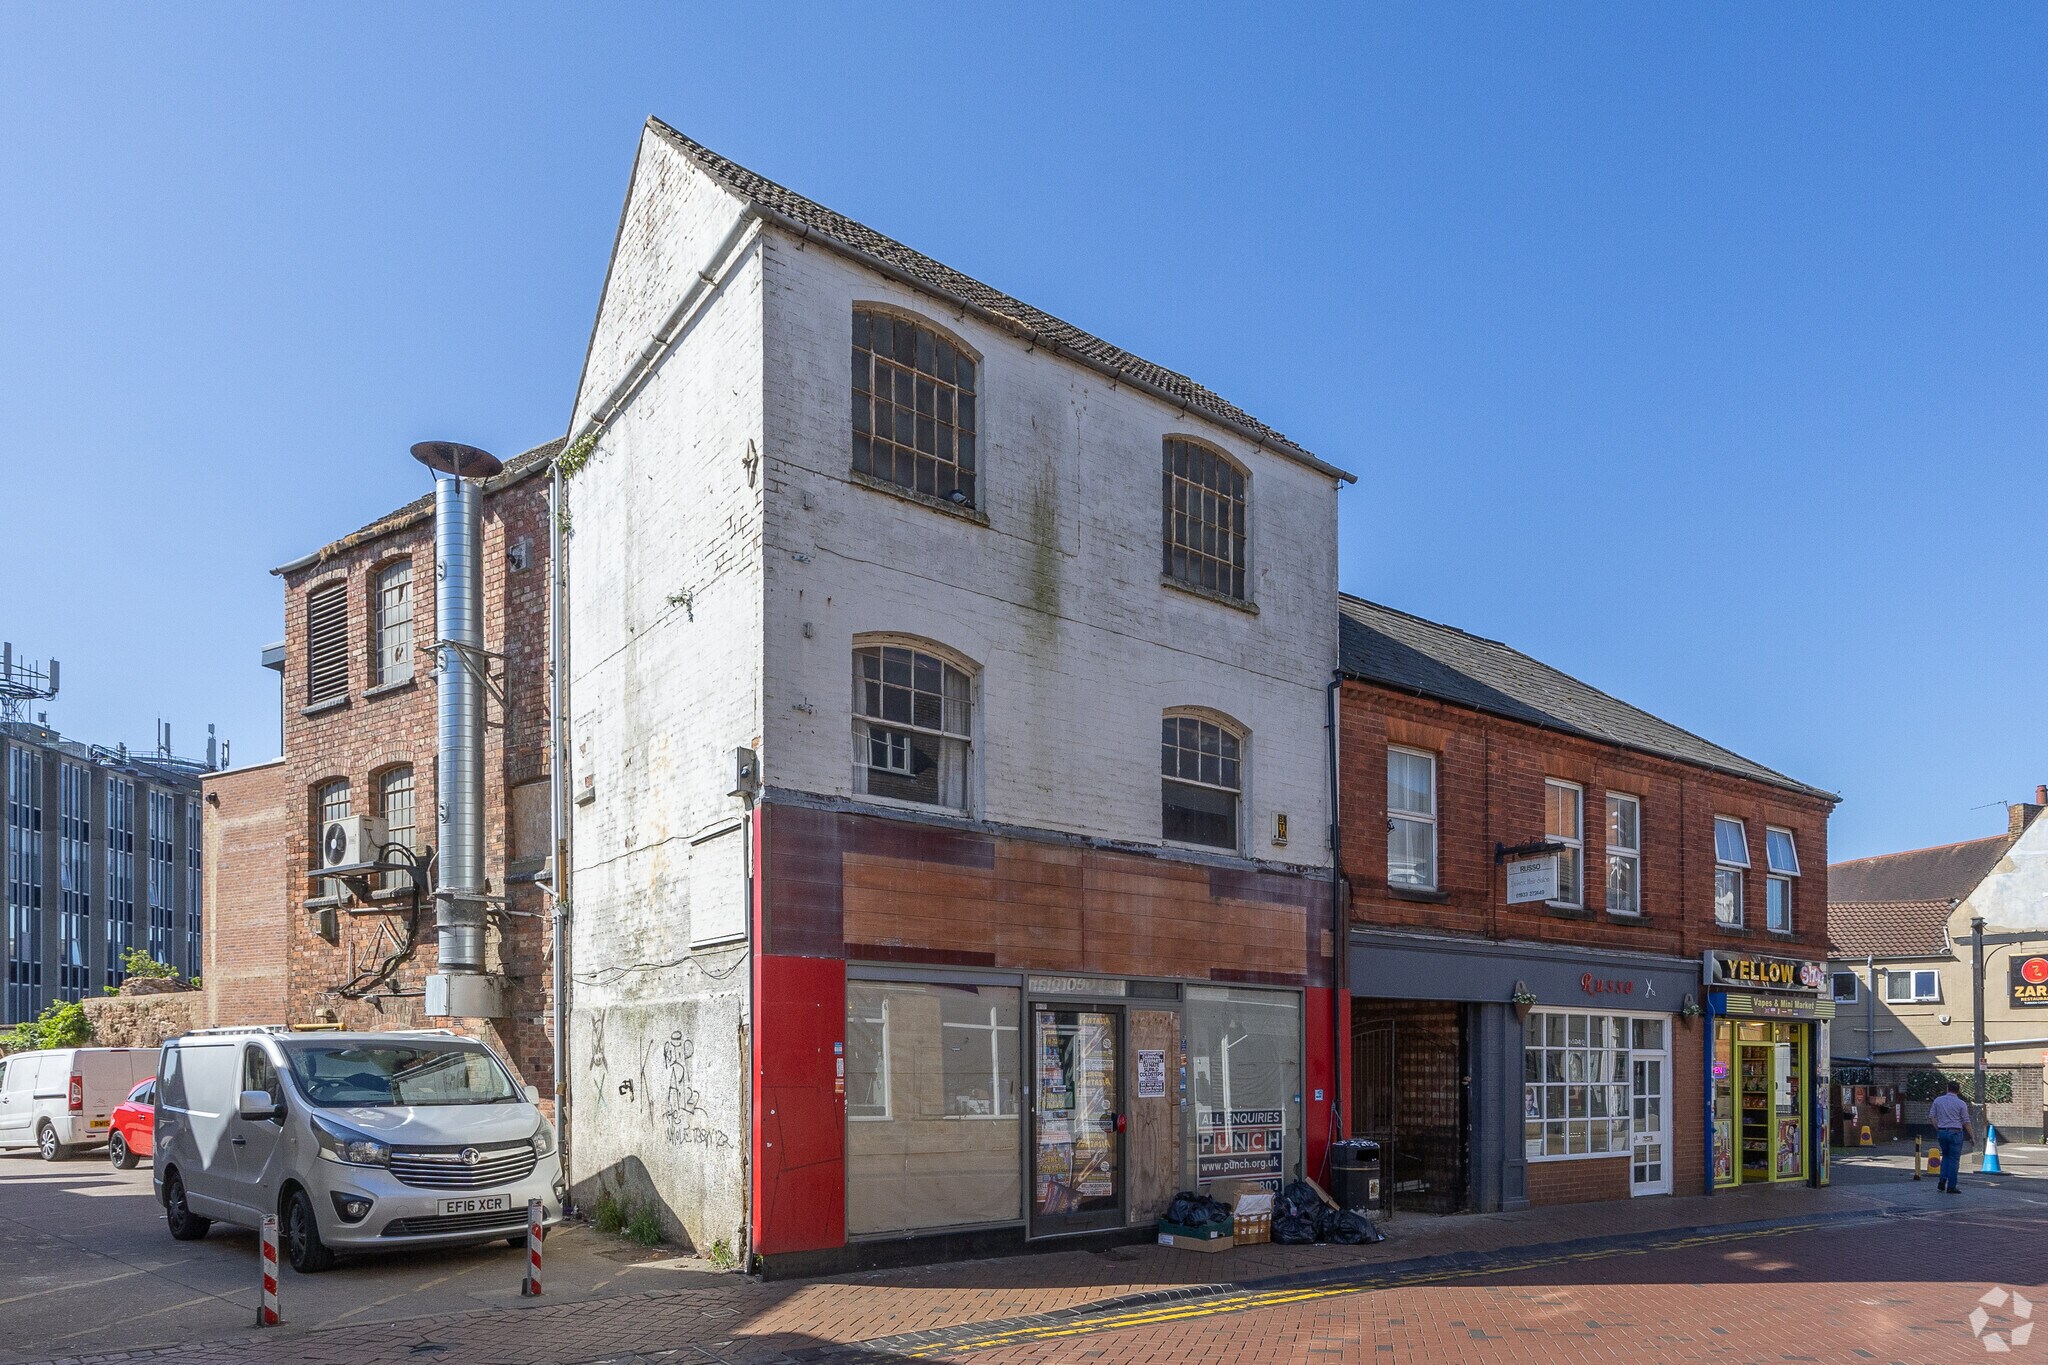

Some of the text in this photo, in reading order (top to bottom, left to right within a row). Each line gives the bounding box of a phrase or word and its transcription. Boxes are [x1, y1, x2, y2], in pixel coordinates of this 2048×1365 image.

[1520, 864, 1540, 873] RUSSO
[1727, 959, 1795, 983] YELLOW
[2014, 985, 2048, 997] ZAR
[1753, 998, 1815, 1010] Vapes & Mini Market
[1201, 1112, 1280, 1125] ALL ENQUIRIES
[1201, 1132, 1280, 1152] PUNCH
[1201, 1156, 1279, 1172] www.punch.org.uk
[447, 1198, 502, 1213] EF16 XCR
